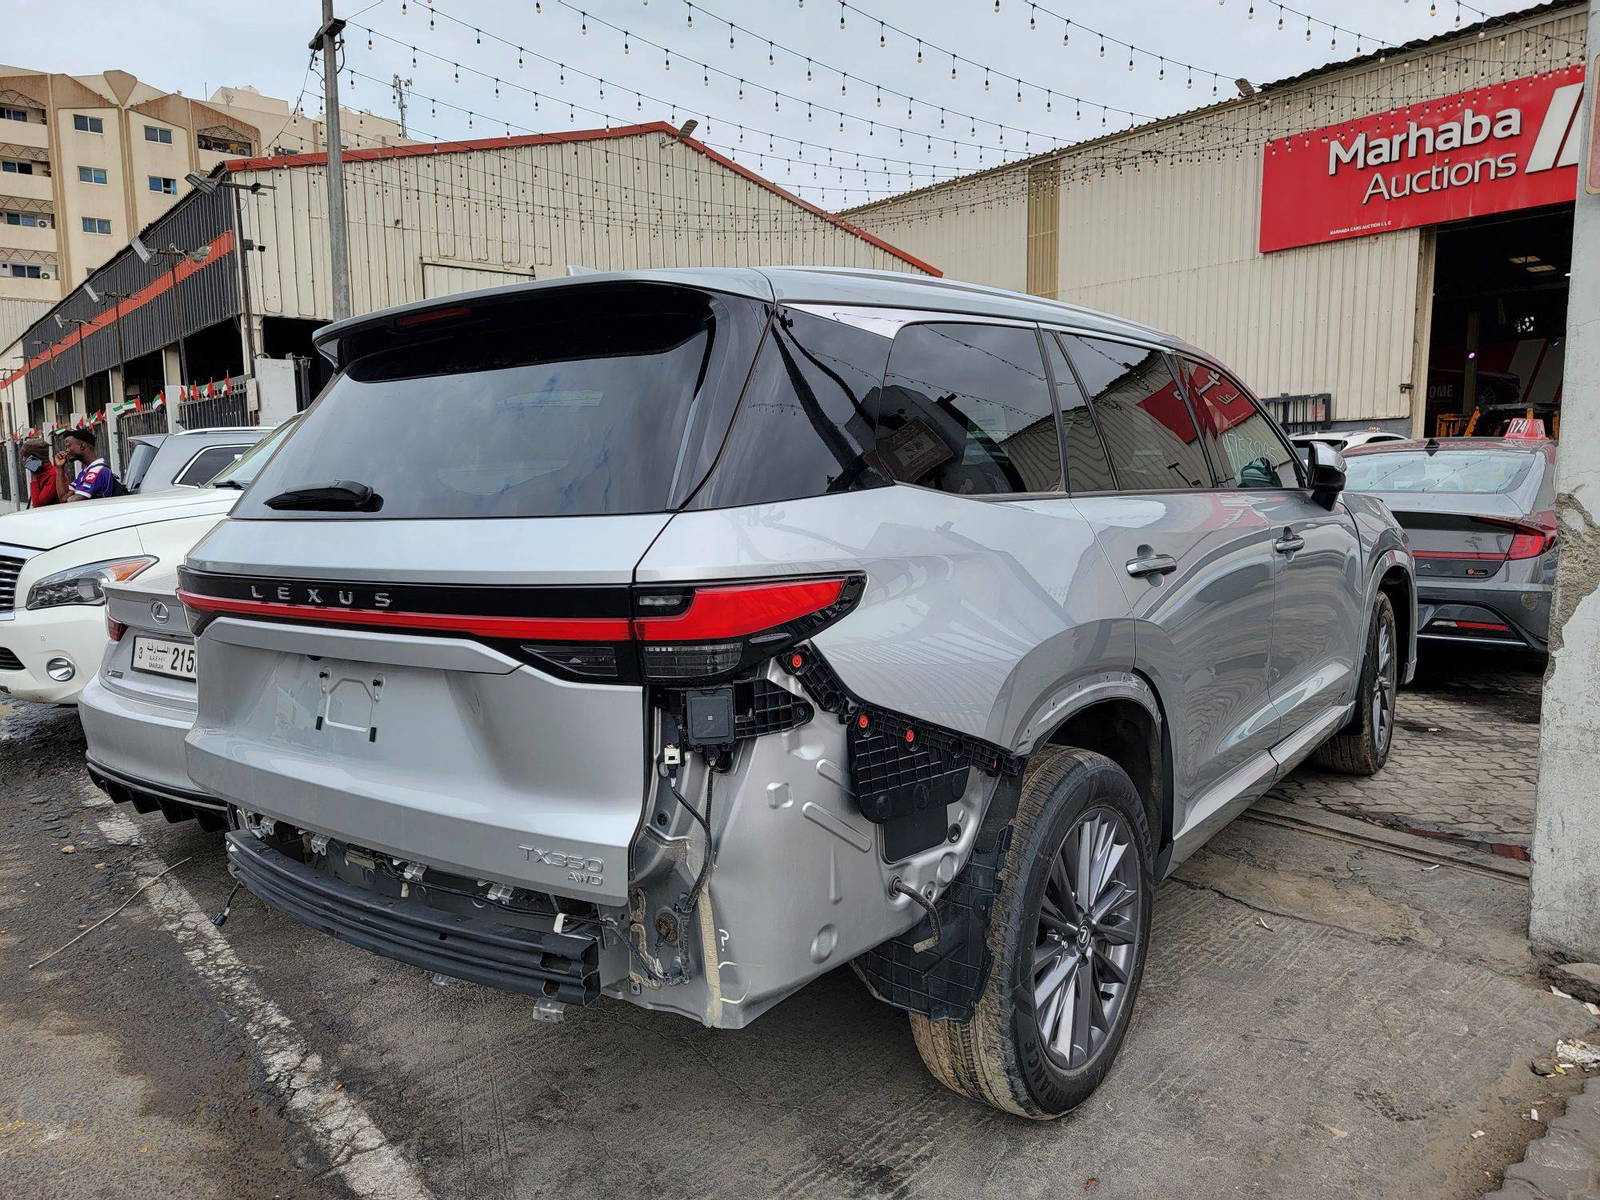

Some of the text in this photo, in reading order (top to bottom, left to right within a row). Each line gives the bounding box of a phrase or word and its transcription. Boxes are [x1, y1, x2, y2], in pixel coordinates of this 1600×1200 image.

[1328, 107, 1521, 176] Marhaba
[1362, 152, 1518, 204] Auctions
[251, 585, 391, 607] LEXUS
[138, 646, 196, 672] 3 215
[518, 845, 604, 873] TX350
[567, 871, 604, 886] AWD
